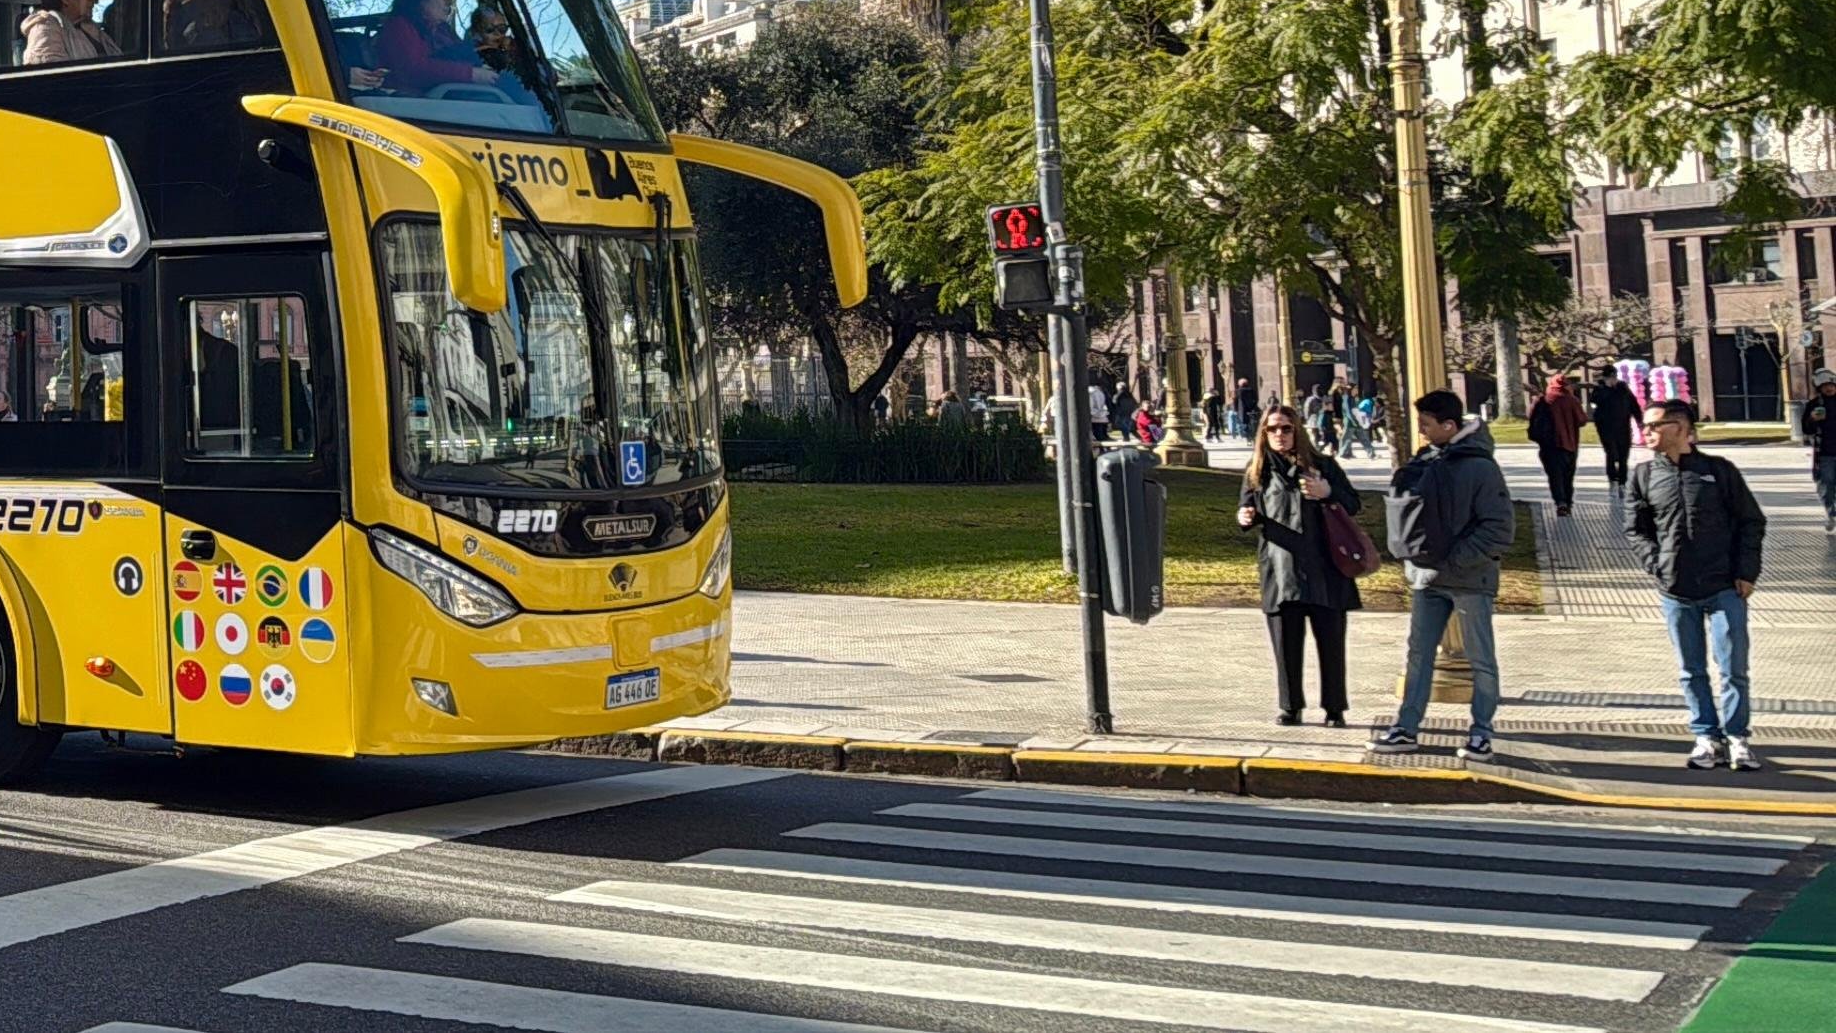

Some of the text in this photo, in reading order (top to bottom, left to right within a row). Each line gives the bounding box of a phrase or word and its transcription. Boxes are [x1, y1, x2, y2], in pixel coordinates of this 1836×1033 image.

[497, 509, 558, 533] 2270
[594, 519, 650, 537] METALSUR
[610, 685, 622, 706] AG
